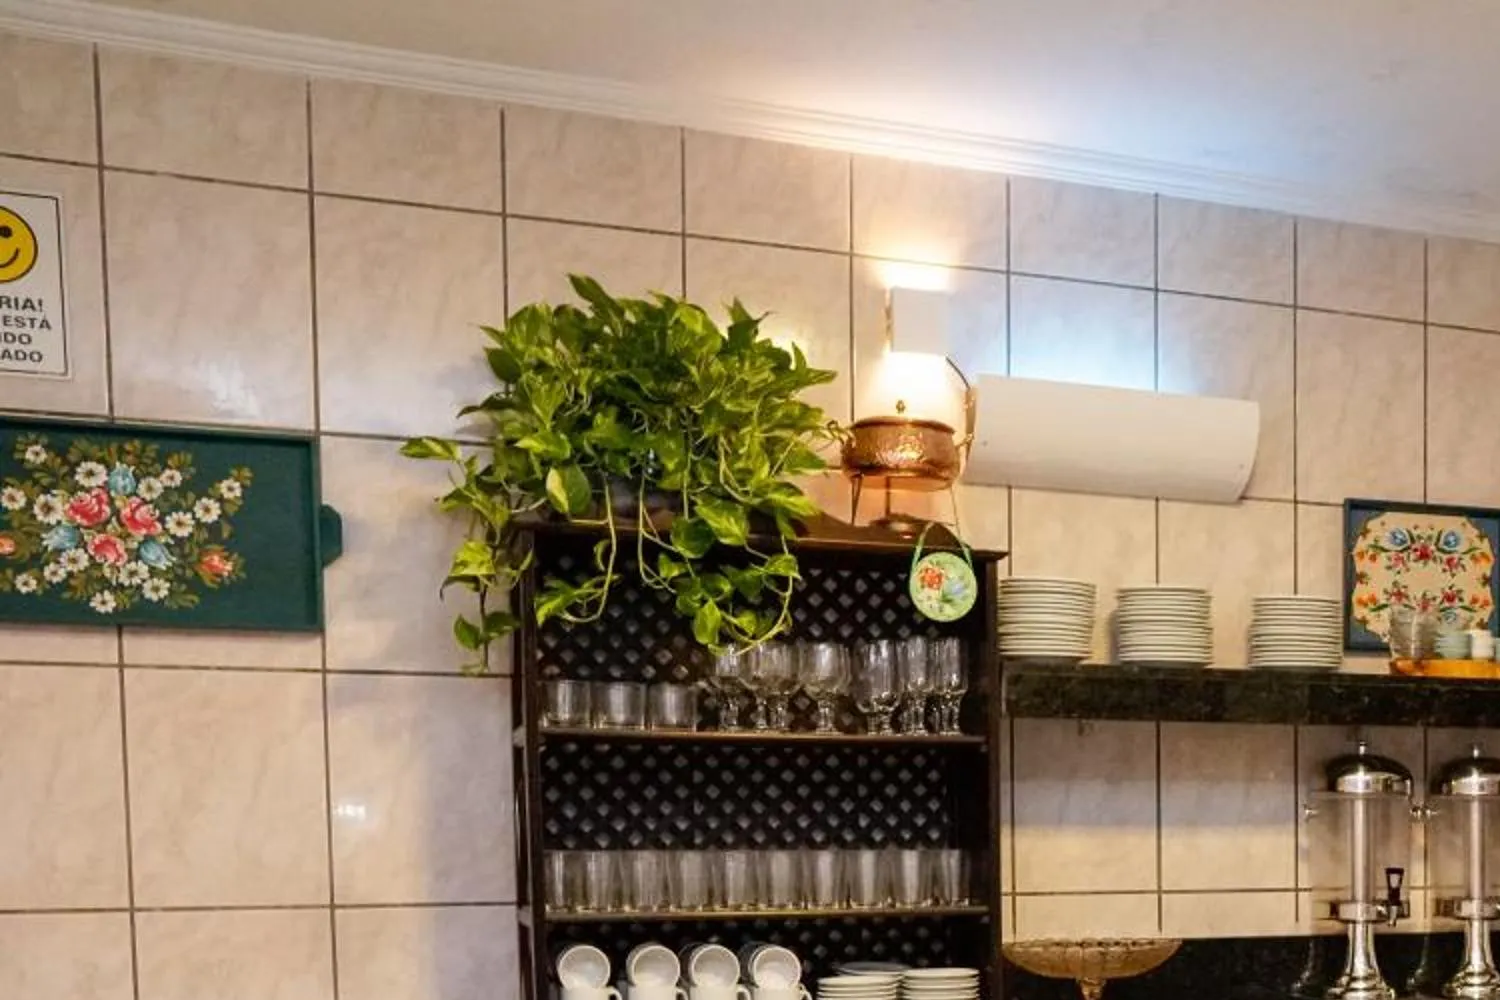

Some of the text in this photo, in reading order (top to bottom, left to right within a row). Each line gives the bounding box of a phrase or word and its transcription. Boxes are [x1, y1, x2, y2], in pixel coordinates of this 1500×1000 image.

[0, 296, 43, 312] RIA!
[0, 332, 32, 345] DO
[1, 349, 43, 362] ADO
